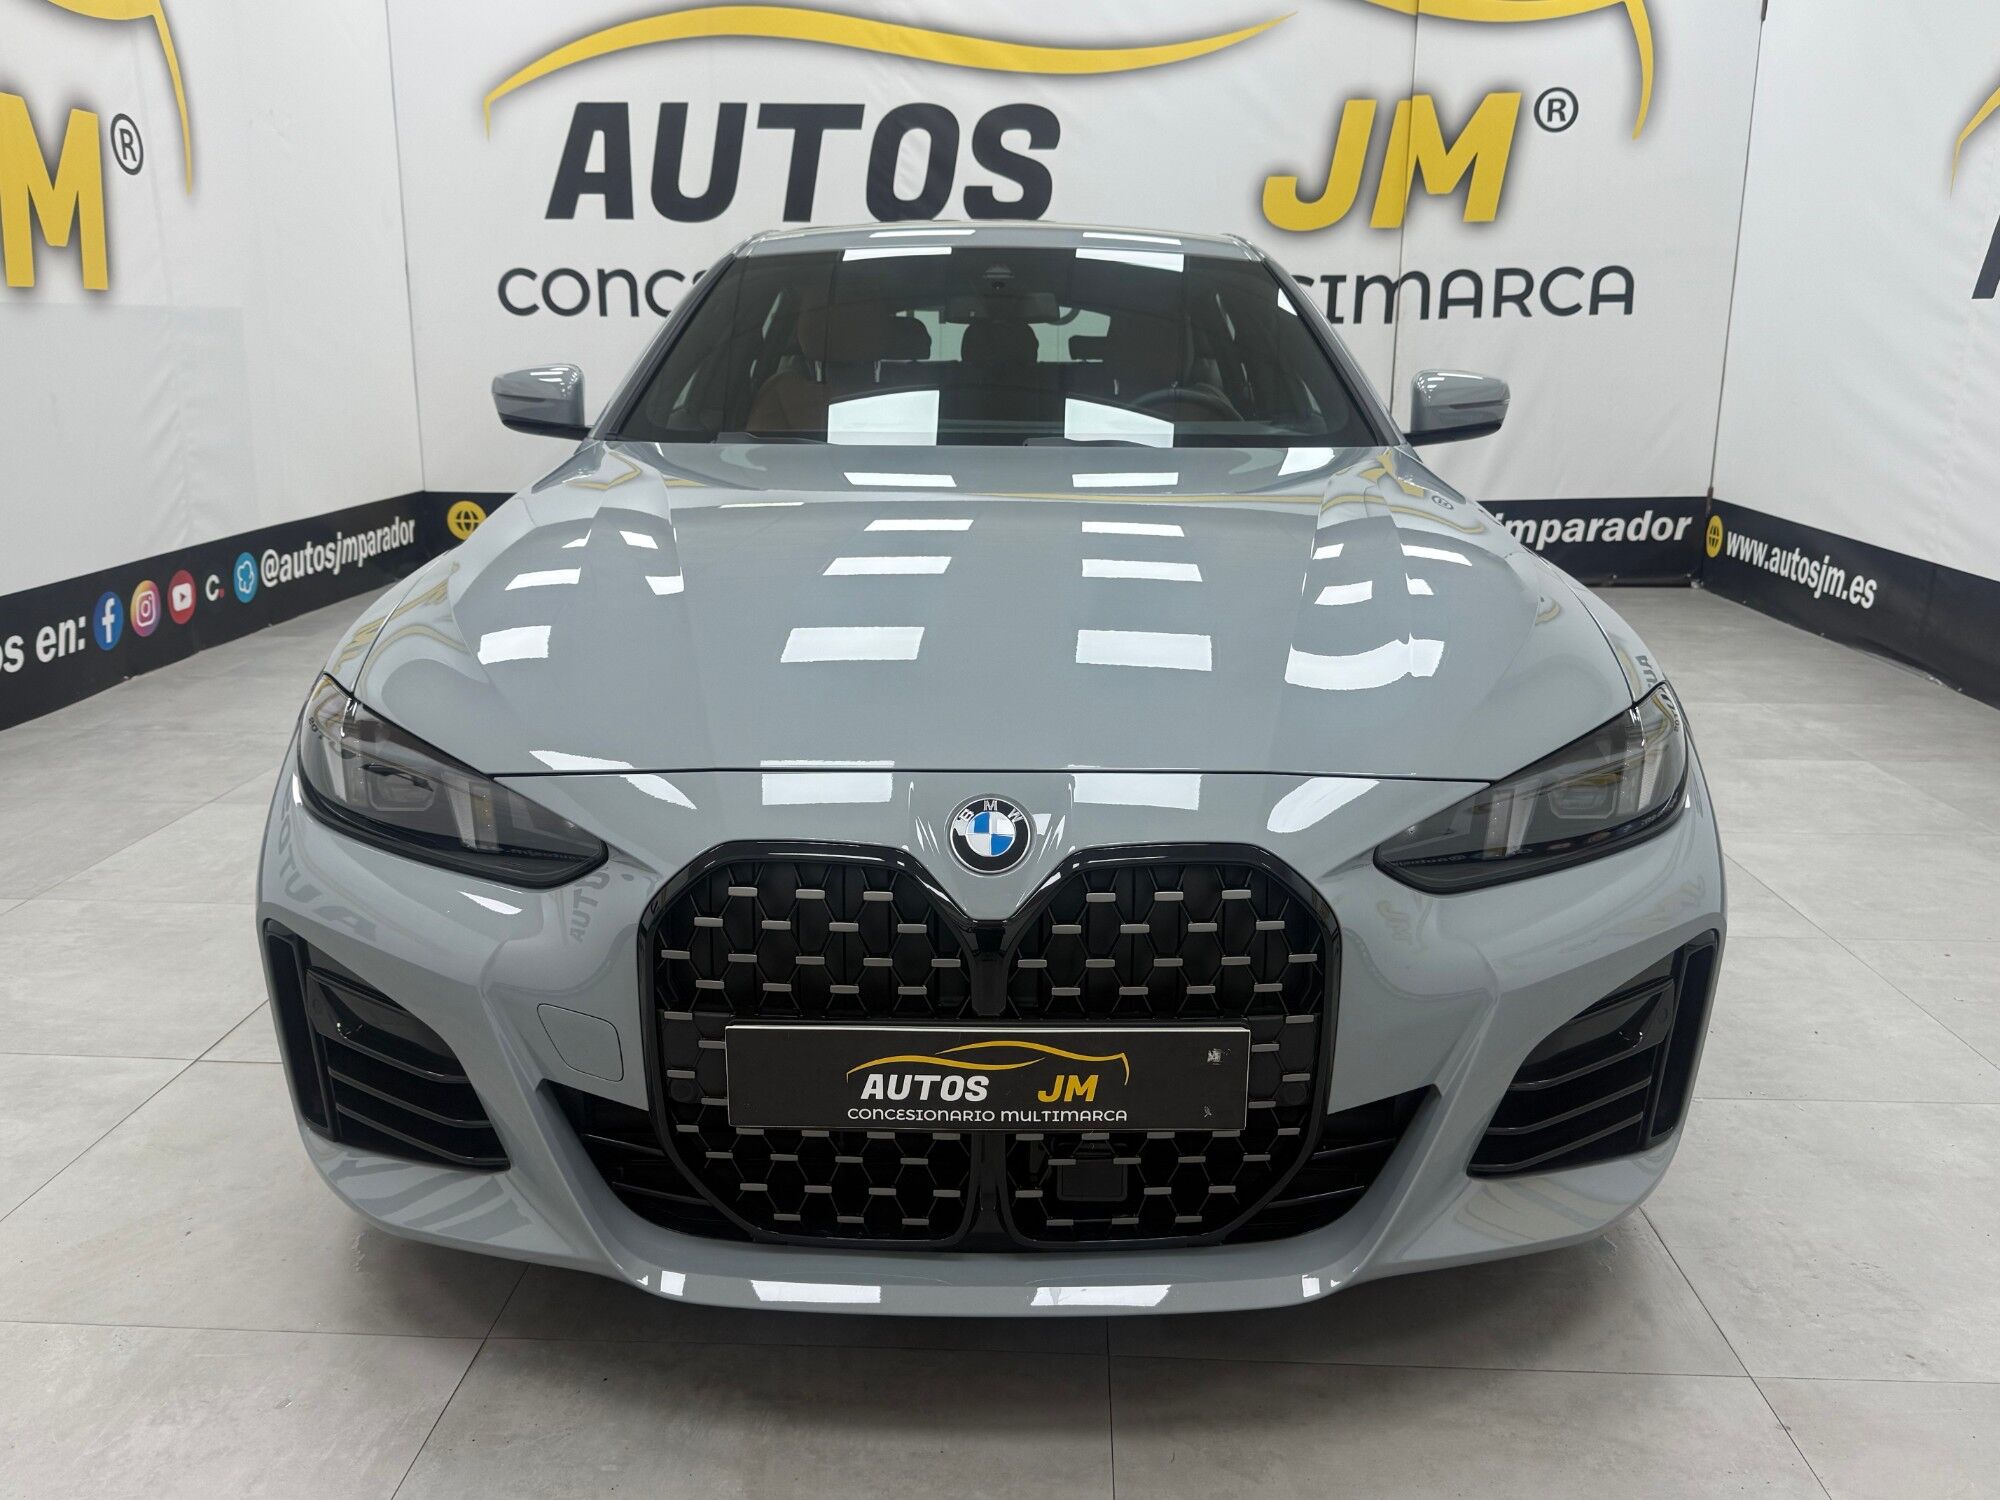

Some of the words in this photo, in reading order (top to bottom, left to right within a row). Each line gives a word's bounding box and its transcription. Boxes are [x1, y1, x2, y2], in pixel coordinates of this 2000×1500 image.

[545, 102, 1061, 222] AUTOS
[1263, 92, 1521, 231] JM
[1494, 500, 1693, 551] mparador
[0, 634, 24, 673] s
[36, 616, 86, 663] en:
[261, 516, 415, 588] @autosjmparador
[1726, 531, 1877, 609] www.autosjm.es
[958, 800, 1024, 824] BMW
[861, 1073, 989, 1102] AUTOS
[1037, 1074, 1099, 1103] JM
[847, 1108, 995, 1122] CONCESIONARIO
[1001, 1109, 1128, 1122] MULTIMARCA
